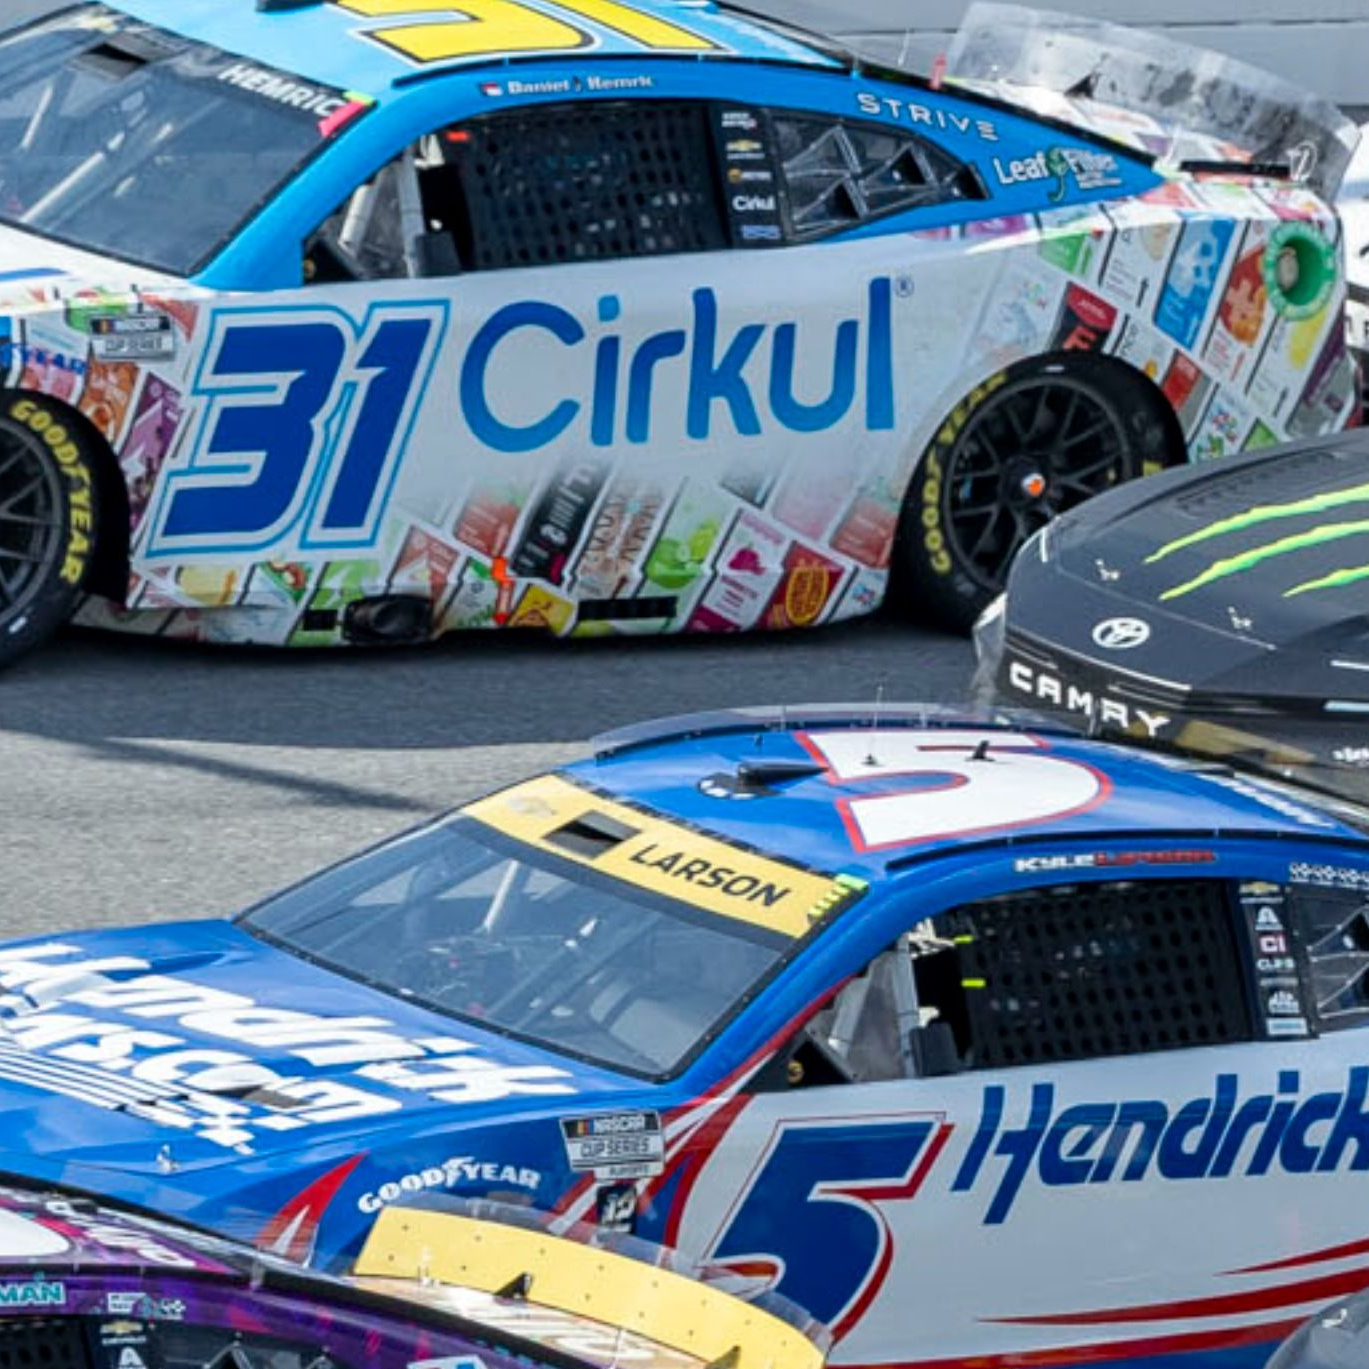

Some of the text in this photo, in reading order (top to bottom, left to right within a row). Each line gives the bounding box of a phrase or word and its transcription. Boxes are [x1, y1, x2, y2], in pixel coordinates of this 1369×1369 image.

[216, 62, 346, 117] HEMRIC
[857, 93, 1001, 142] STRIVE
[457, 276, 895, 453] Cirkul
[144, 298, 451, 558] 31
[10, 399, 93, 585] GOODYEAR
[1009, 661, 1171, 738] CAMRY
[794, 730, 1112, 852] 5
[630, 842, 792, 908] LARSON
[357, 1156, 543, 1214] GOODYEAR
[703, 1112, 955, 1345] 5
